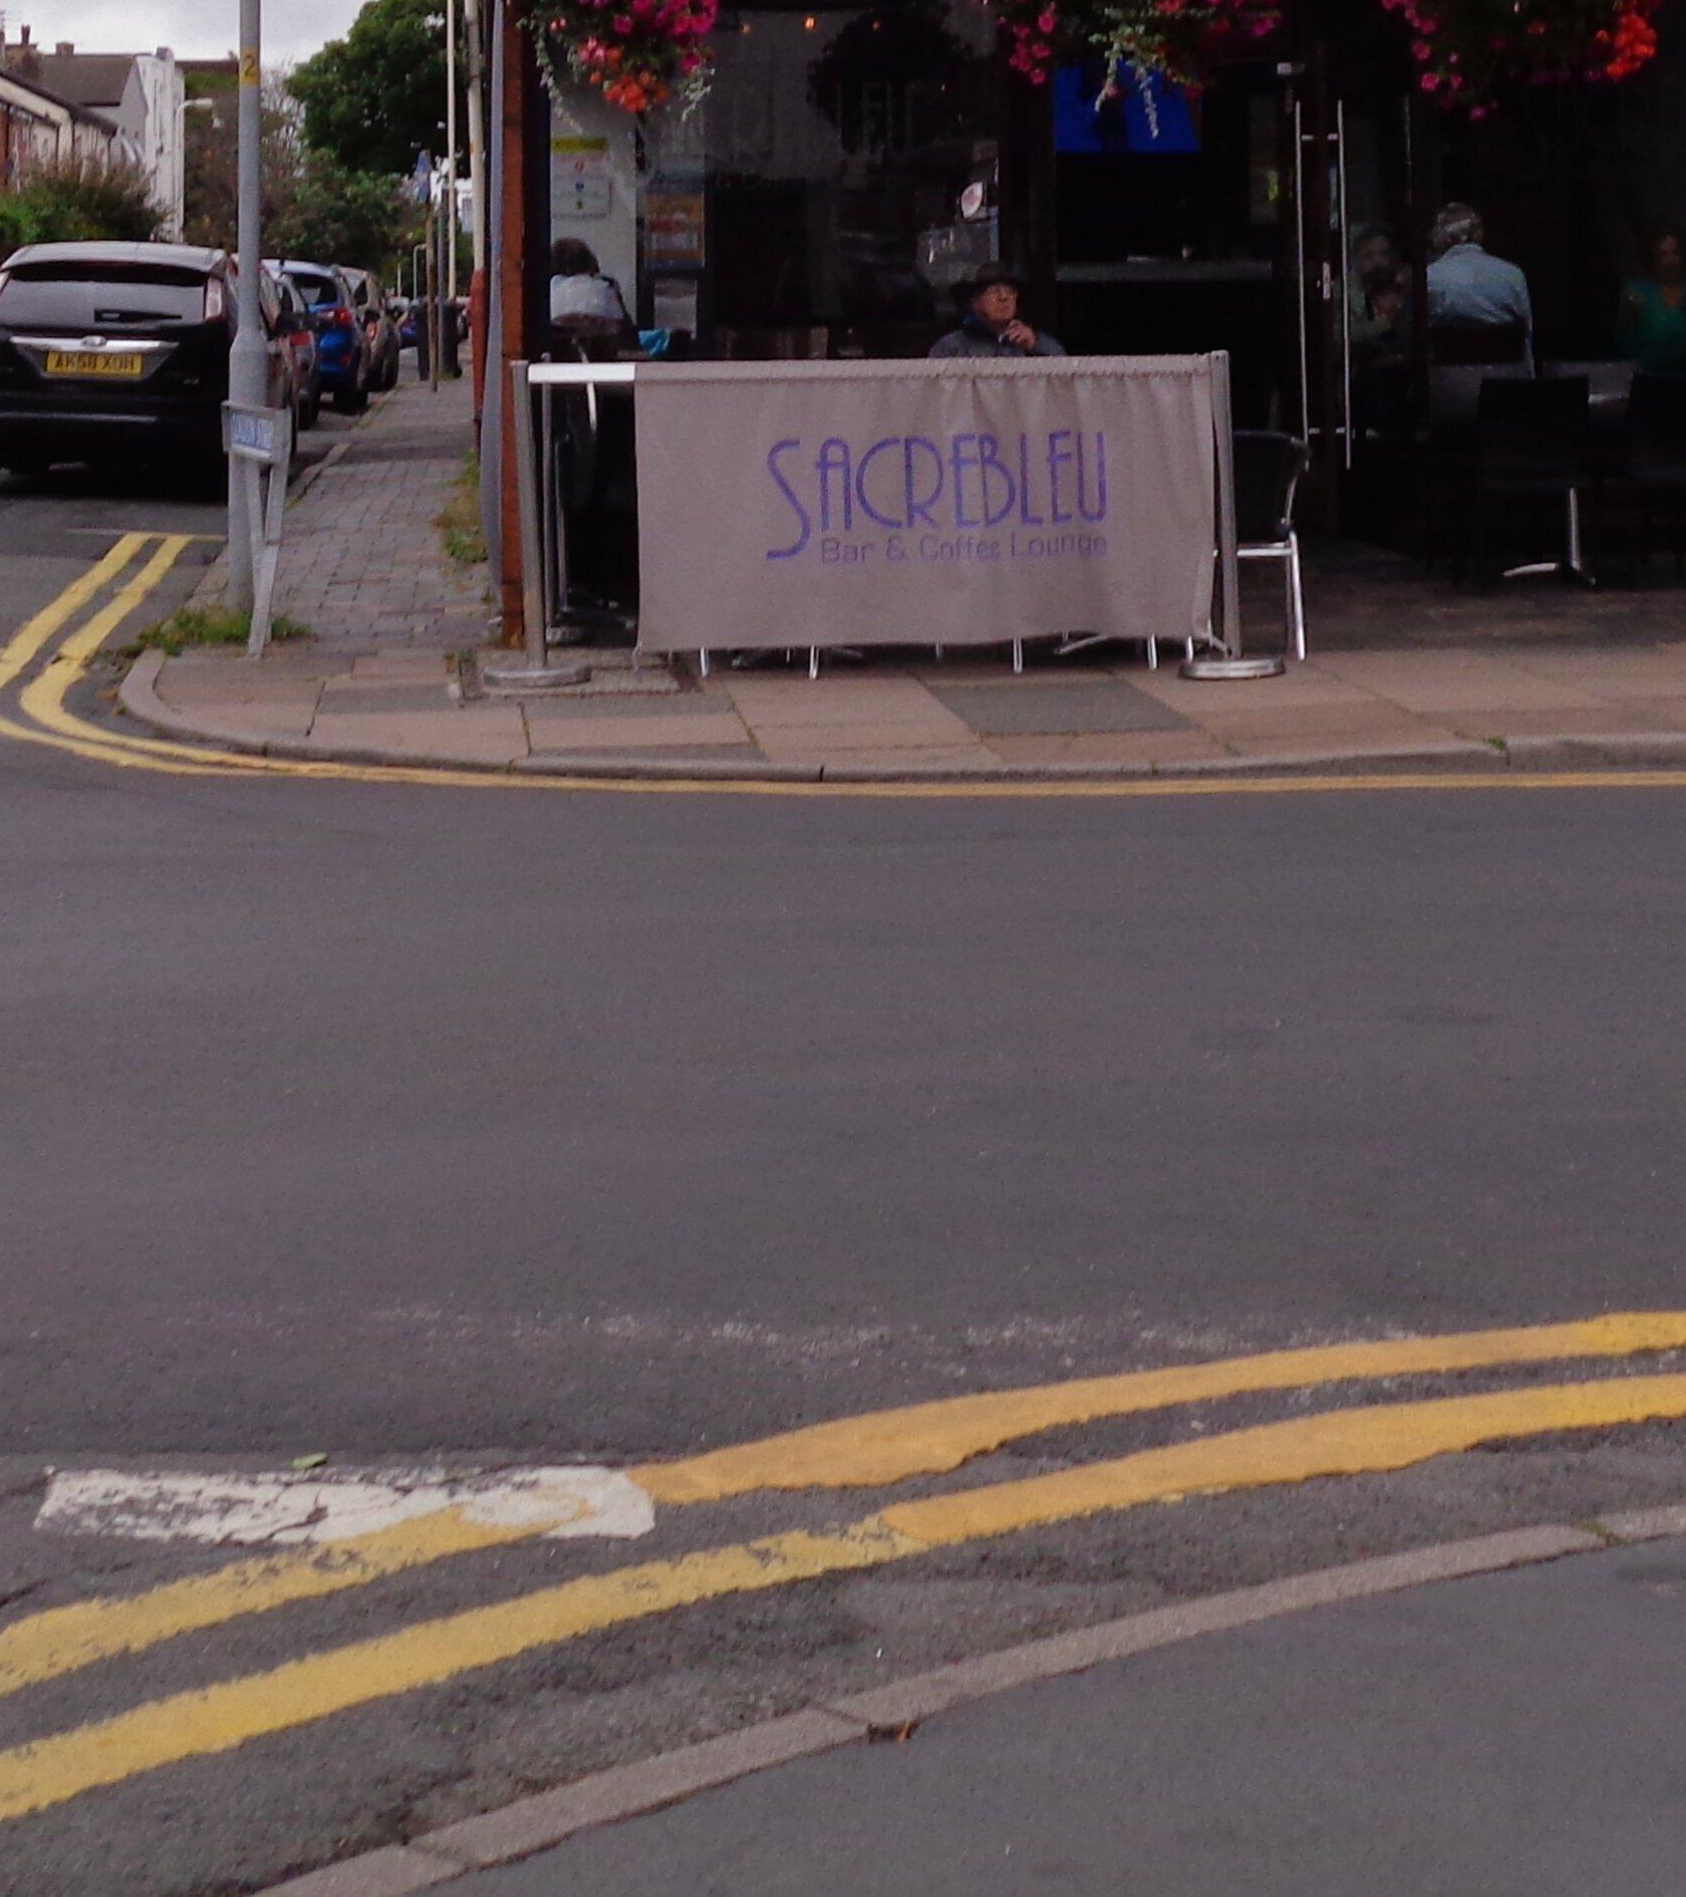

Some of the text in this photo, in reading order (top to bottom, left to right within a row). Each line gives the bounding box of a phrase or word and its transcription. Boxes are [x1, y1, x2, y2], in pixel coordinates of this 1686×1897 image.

[766, 430, 1108, 561] SACREBLEU
[820, 530, 1108, 564] Bar & Coffee Lounge
